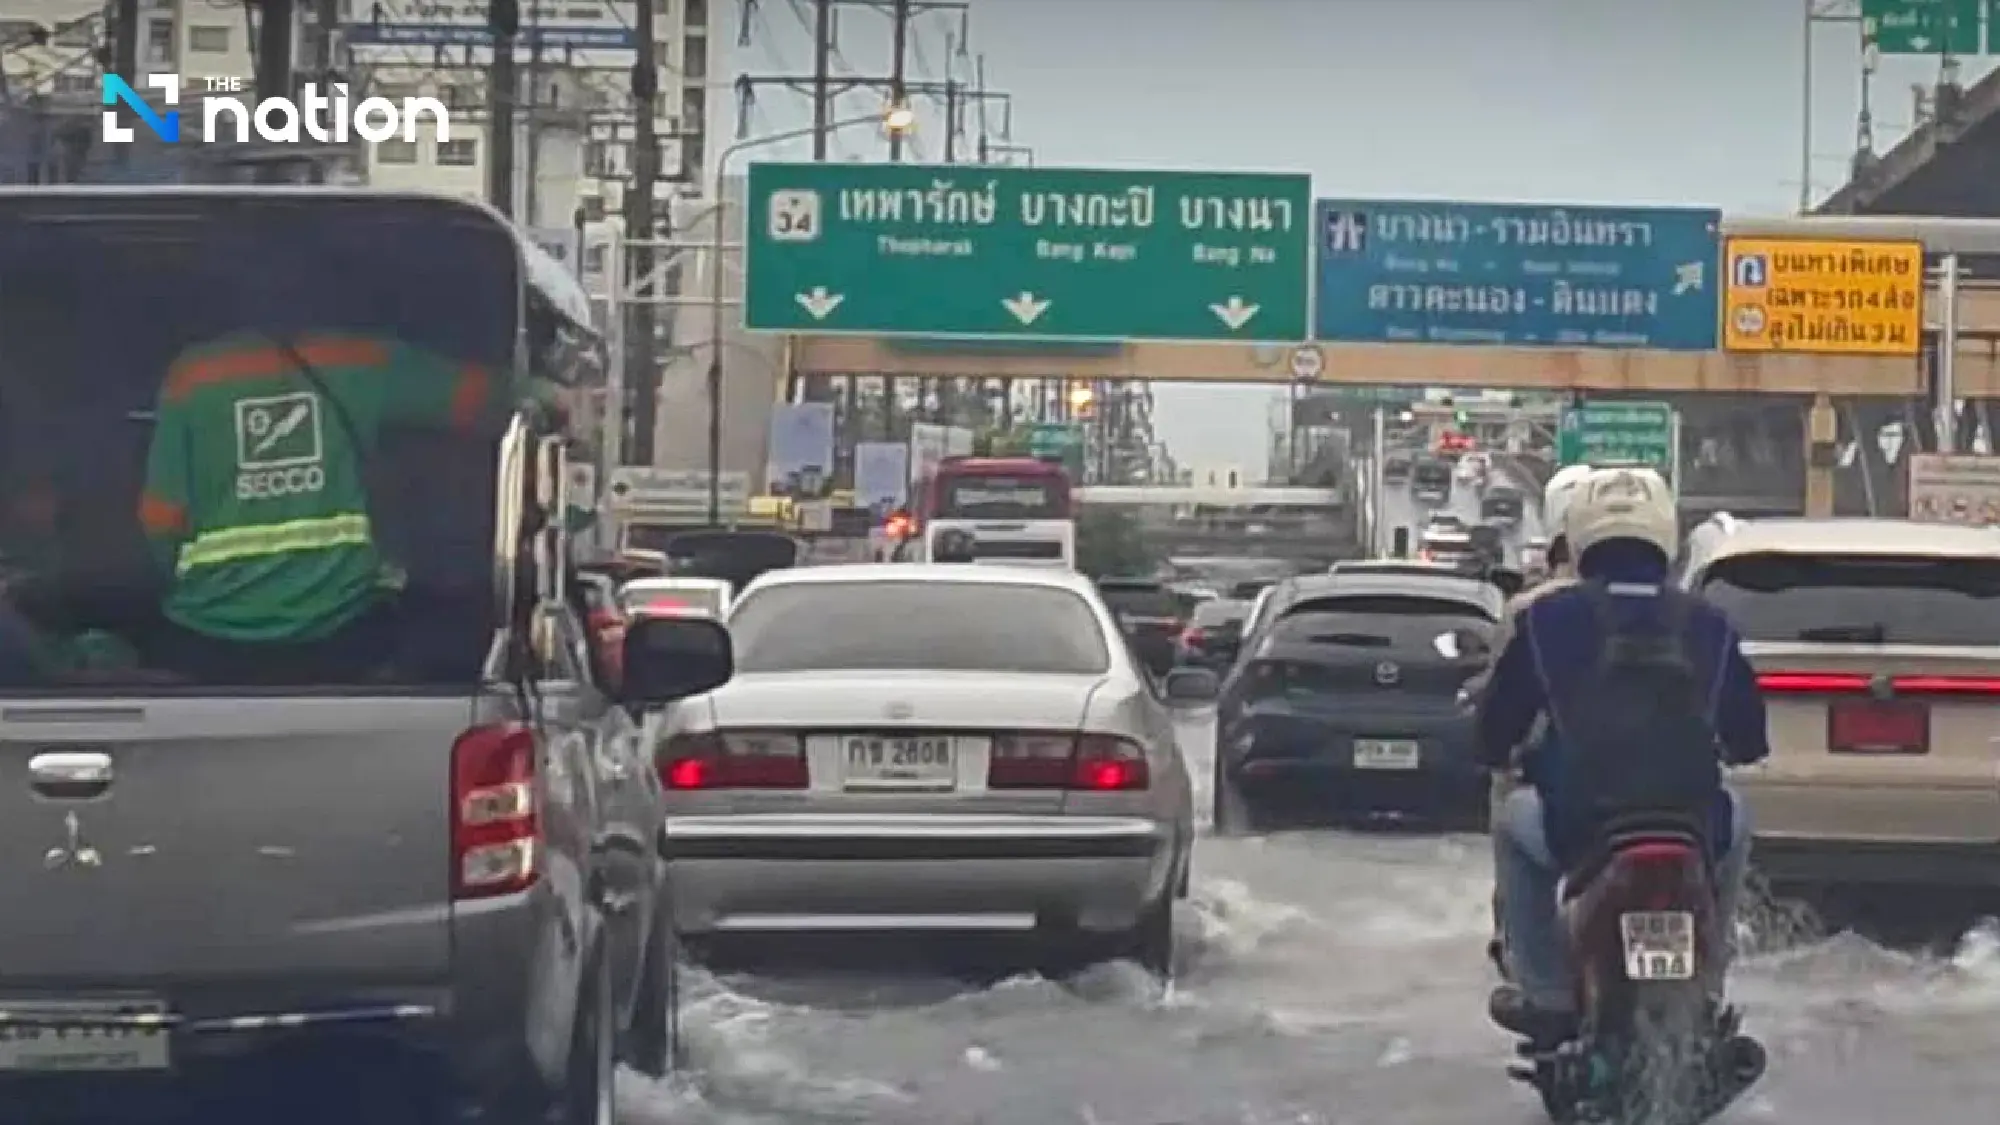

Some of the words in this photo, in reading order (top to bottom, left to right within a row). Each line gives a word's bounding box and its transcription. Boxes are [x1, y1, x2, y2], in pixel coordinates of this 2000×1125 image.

[839, 179, 997, 224] เทพารักษ์
[1021, 185, 1154, 227] บางกะปิ
[1179, 194, 1292, 232] บางนา
[236, 467, 325, 499] SECCO
